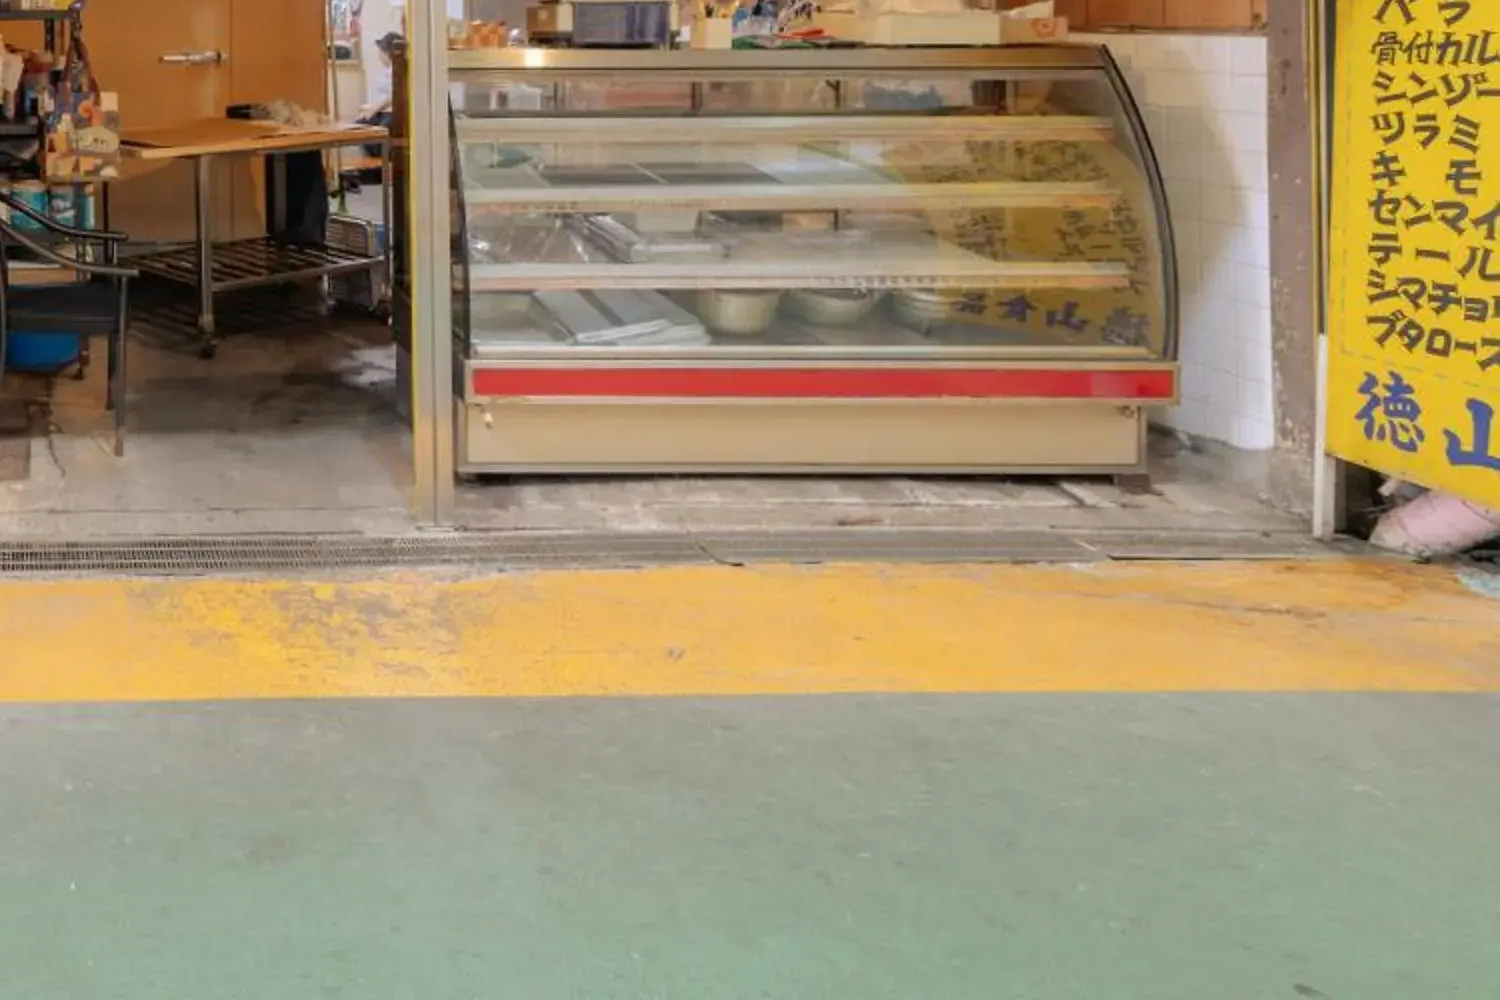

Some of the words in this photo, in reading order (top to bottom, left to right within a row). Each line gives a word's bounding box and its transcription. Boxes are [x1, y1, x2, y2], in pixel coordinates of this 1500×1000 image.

[1370, 111, 1481, 154] ツラミ
[1354, 369, 1500, 471] 徳山
